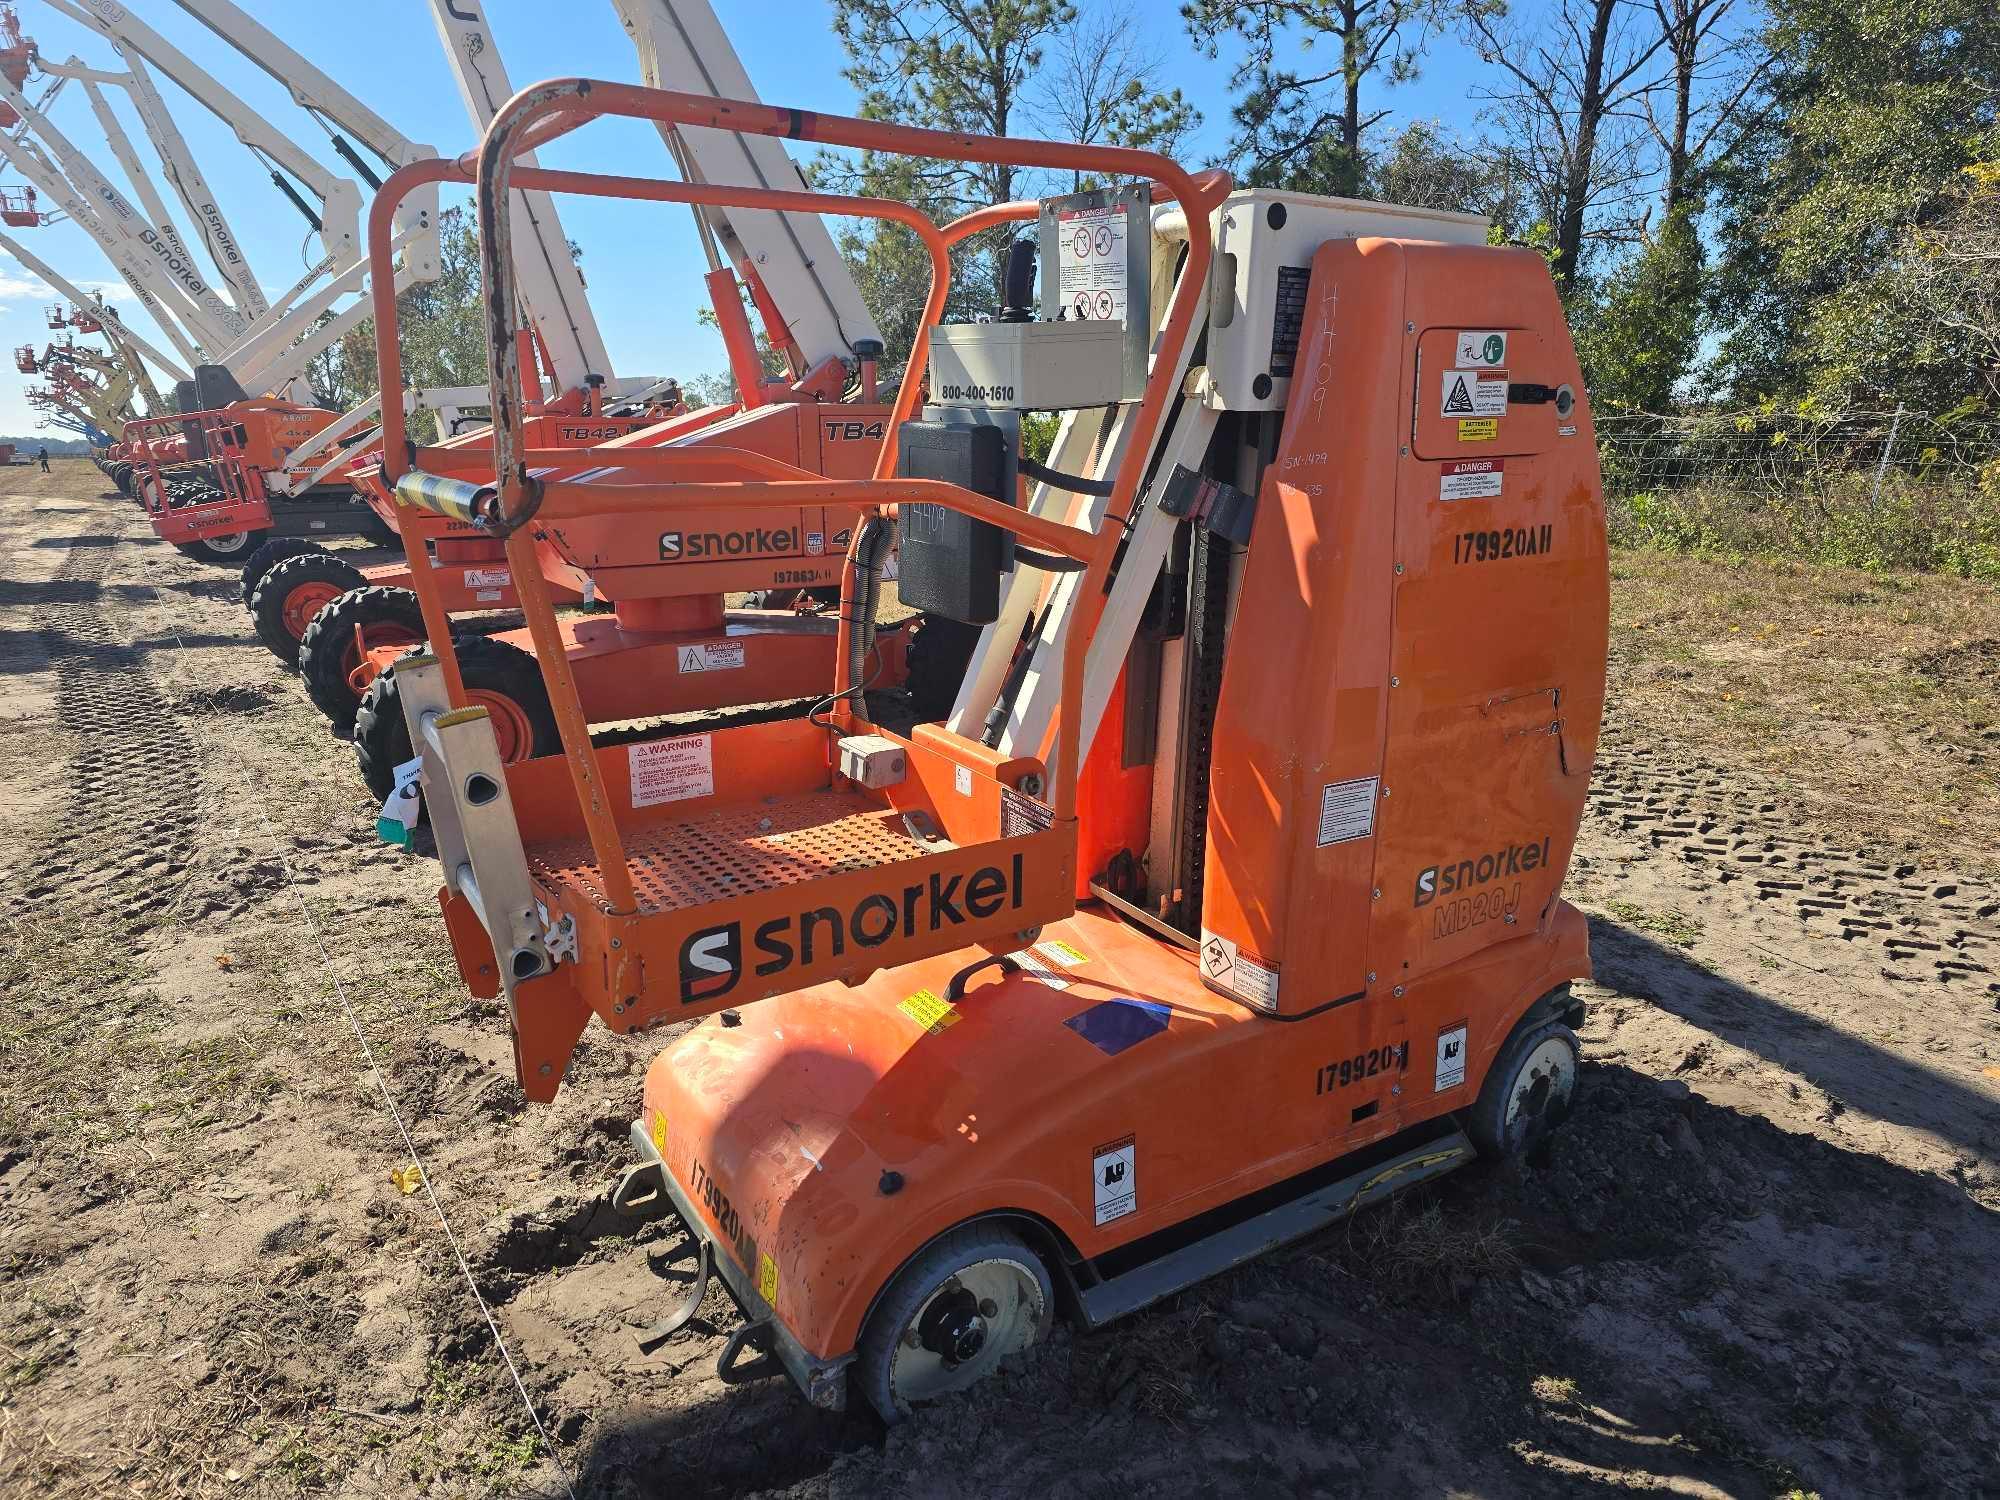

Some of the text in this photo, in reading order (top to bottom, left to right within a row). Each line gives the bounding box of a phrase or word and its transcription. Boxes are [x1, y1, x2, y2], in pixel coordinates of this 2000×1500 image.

[207, 213, 241, 265] snorkel
[151, 239, 207, 296] snorkel
[304, 270, 320, 287] United
[943, 385, 1014, 401] 800-400-1610
[1461, 461, 1493, 472] DANGER
[687, 527, 798, 556] snorkel
[712, 643, 742, 651] DANGER
[649, 739, 703, 755] WARNING
[1440, 837, 1550, 896] snorkel
[753, 853, 1024, 977] snorkel
[1433, 882, 1521, 940] MB20J
[1244, 952, 1278, 971] WARNING
